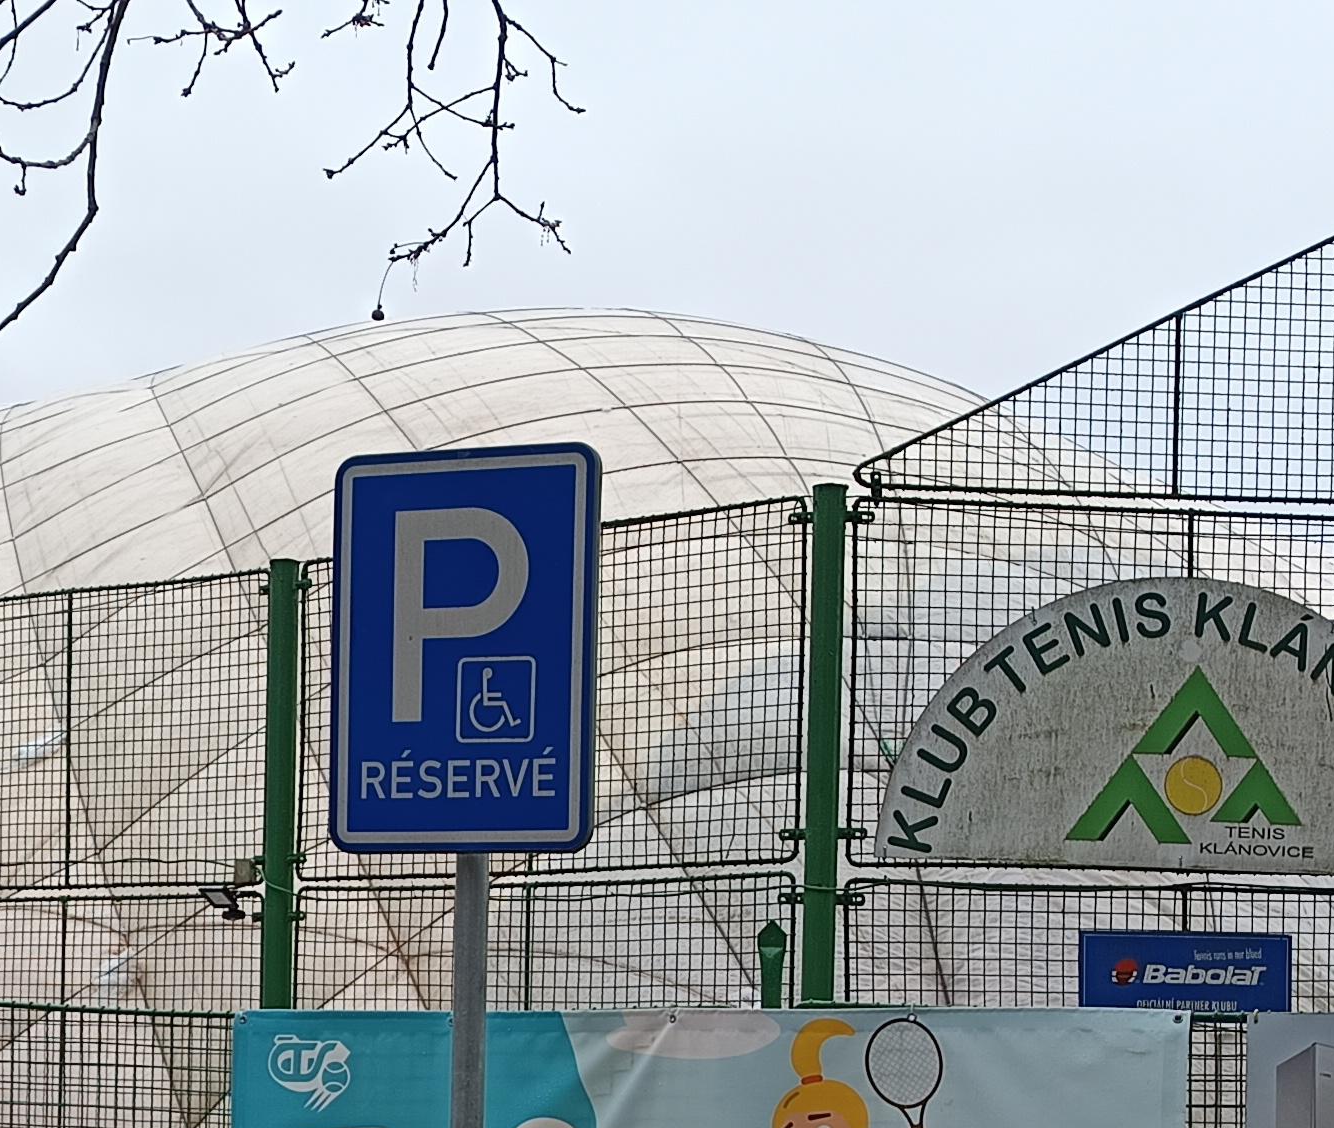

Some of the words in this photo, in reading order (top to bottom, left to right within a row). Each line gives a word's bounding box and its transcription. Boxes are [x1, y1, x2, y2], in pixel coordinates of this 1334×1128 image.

[392, 507, 529, 722] P
[887, 686, 998, 854] KLUB
[984, 592, 1172, 693] TENIS
[361, 746, 556, 800] RÉSERVÉ
[1199, 842, 1314, 859] KLÁNOVICE
[1225, 825, 1285, 840] TENIS
